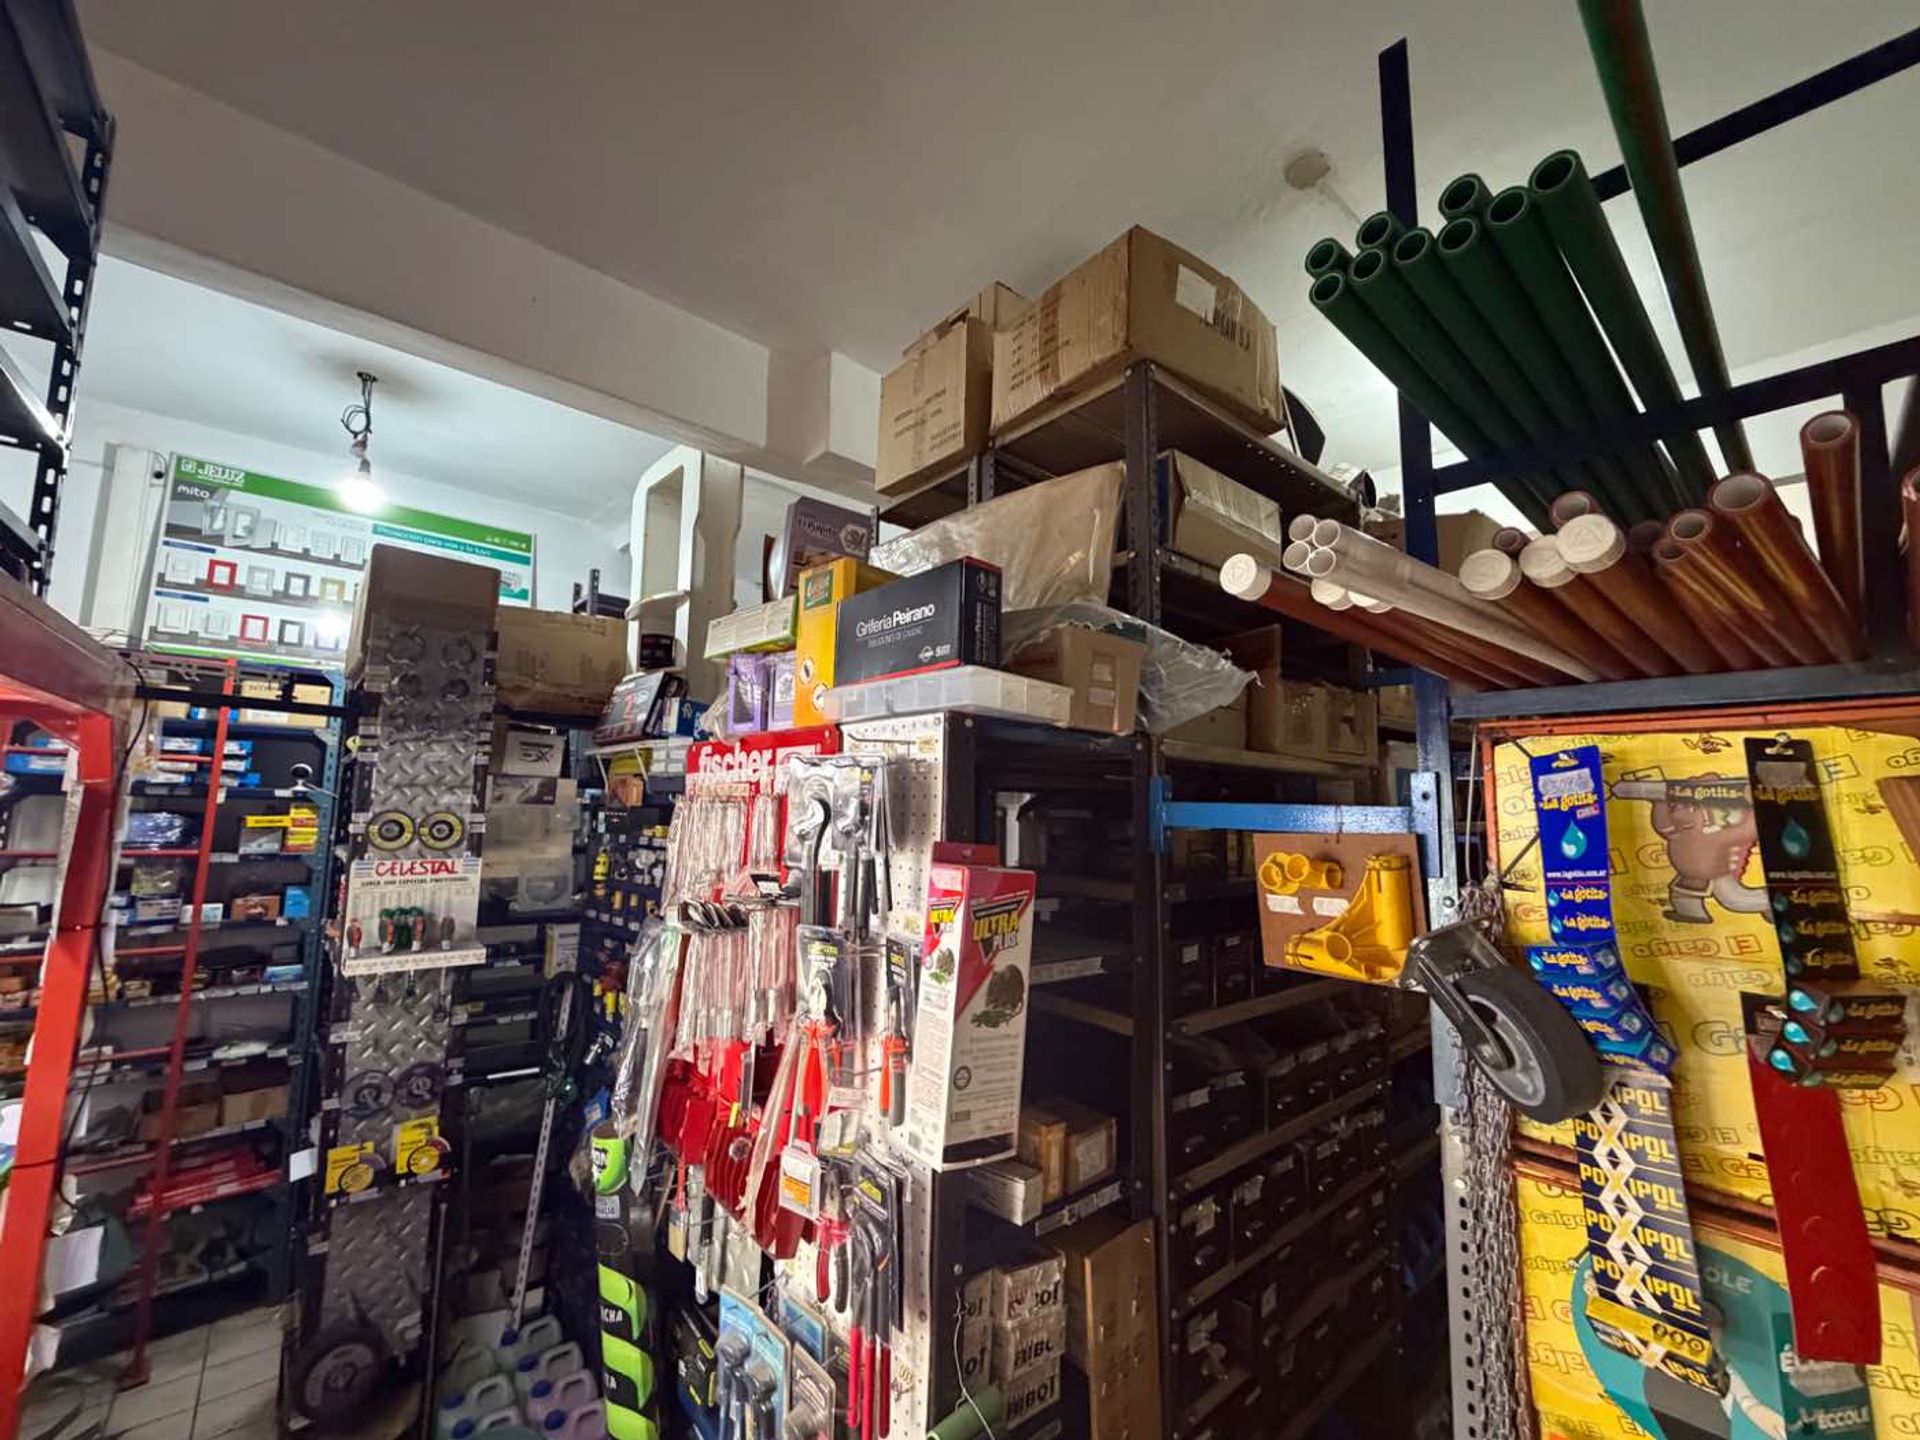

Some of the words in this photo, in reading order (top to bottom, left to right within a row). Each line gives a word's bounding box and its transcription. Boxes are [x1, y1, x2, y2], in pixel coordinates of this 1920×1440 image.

[198, 463, 245, 483] JELUZ
[177, 485, 210, 499] mito
[893, 604, 935, 627] Peirano
[700, 742, 774, 777] fischer
[375, 860, 458, 877] CELESTAL
[973, 911, 1020, 941] ULTRA
